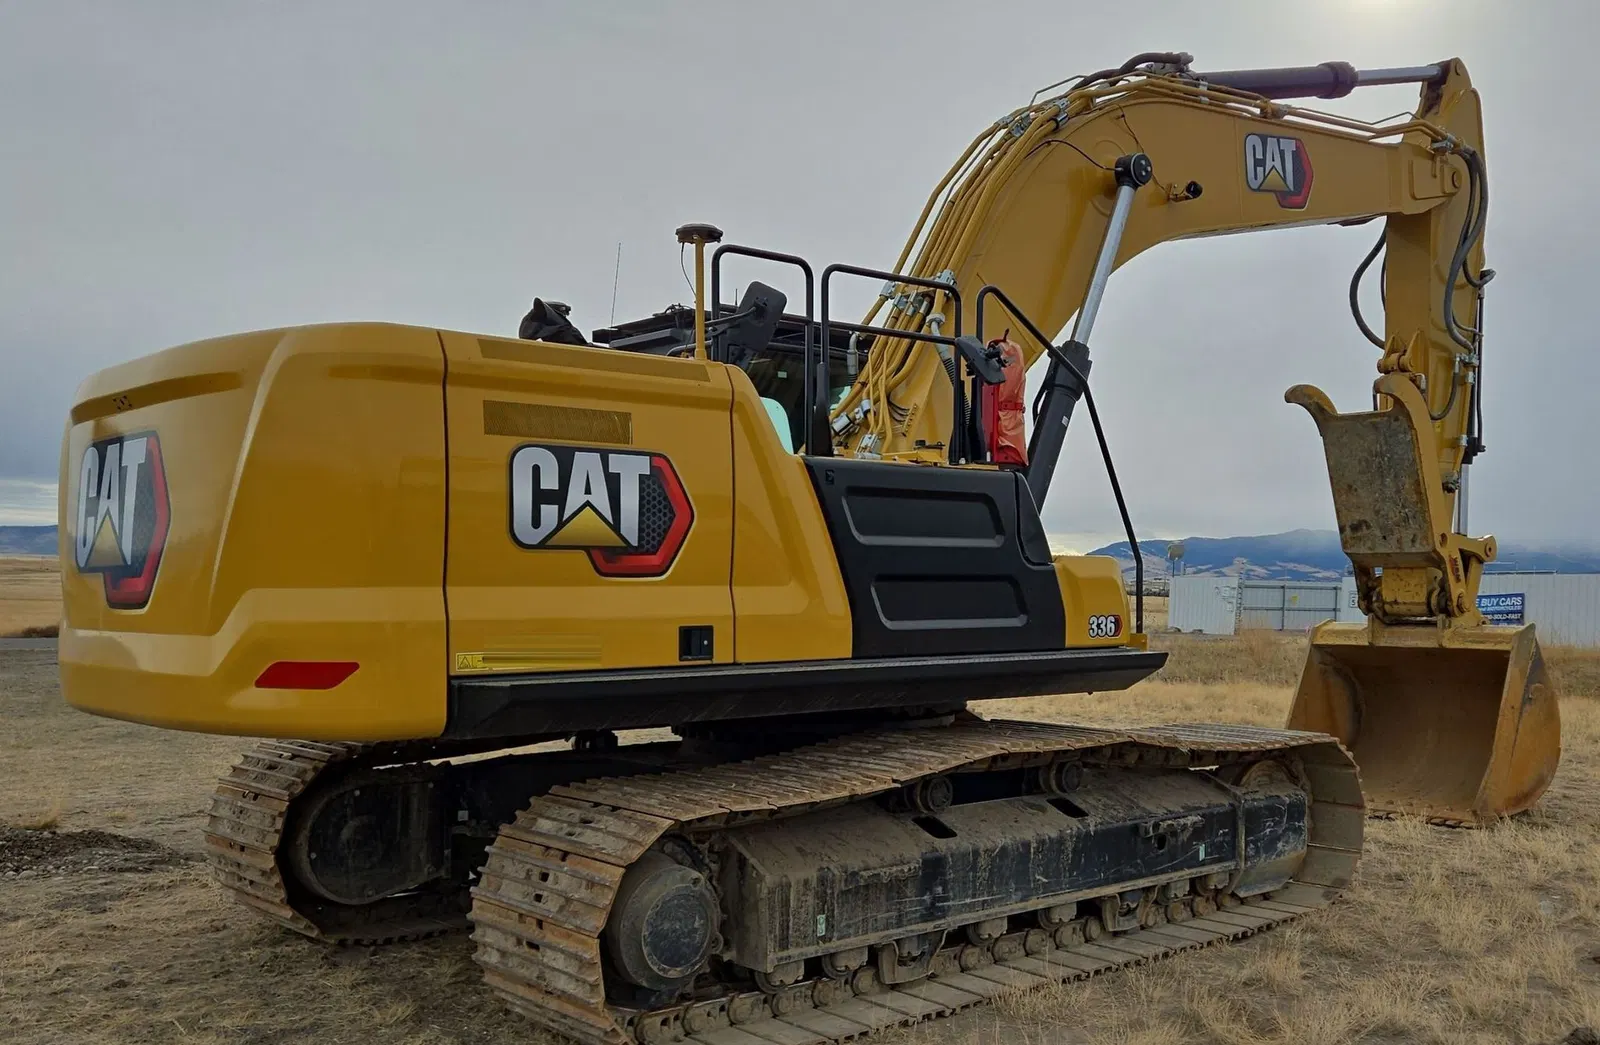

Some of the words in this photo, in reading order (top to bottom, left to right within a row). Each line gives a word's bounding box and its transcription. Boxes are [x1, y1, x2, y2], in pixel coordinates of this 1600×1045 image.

[1245, 134, 1296, 191] CAT
[76, 437, 148, 568] CAT
[512, 446, 651, 547] CAT
[1089, 615, 1116, 637] 336
[1480, 597, 1499, 607] BUY
[1499, 596, 1522, 606] CARS
